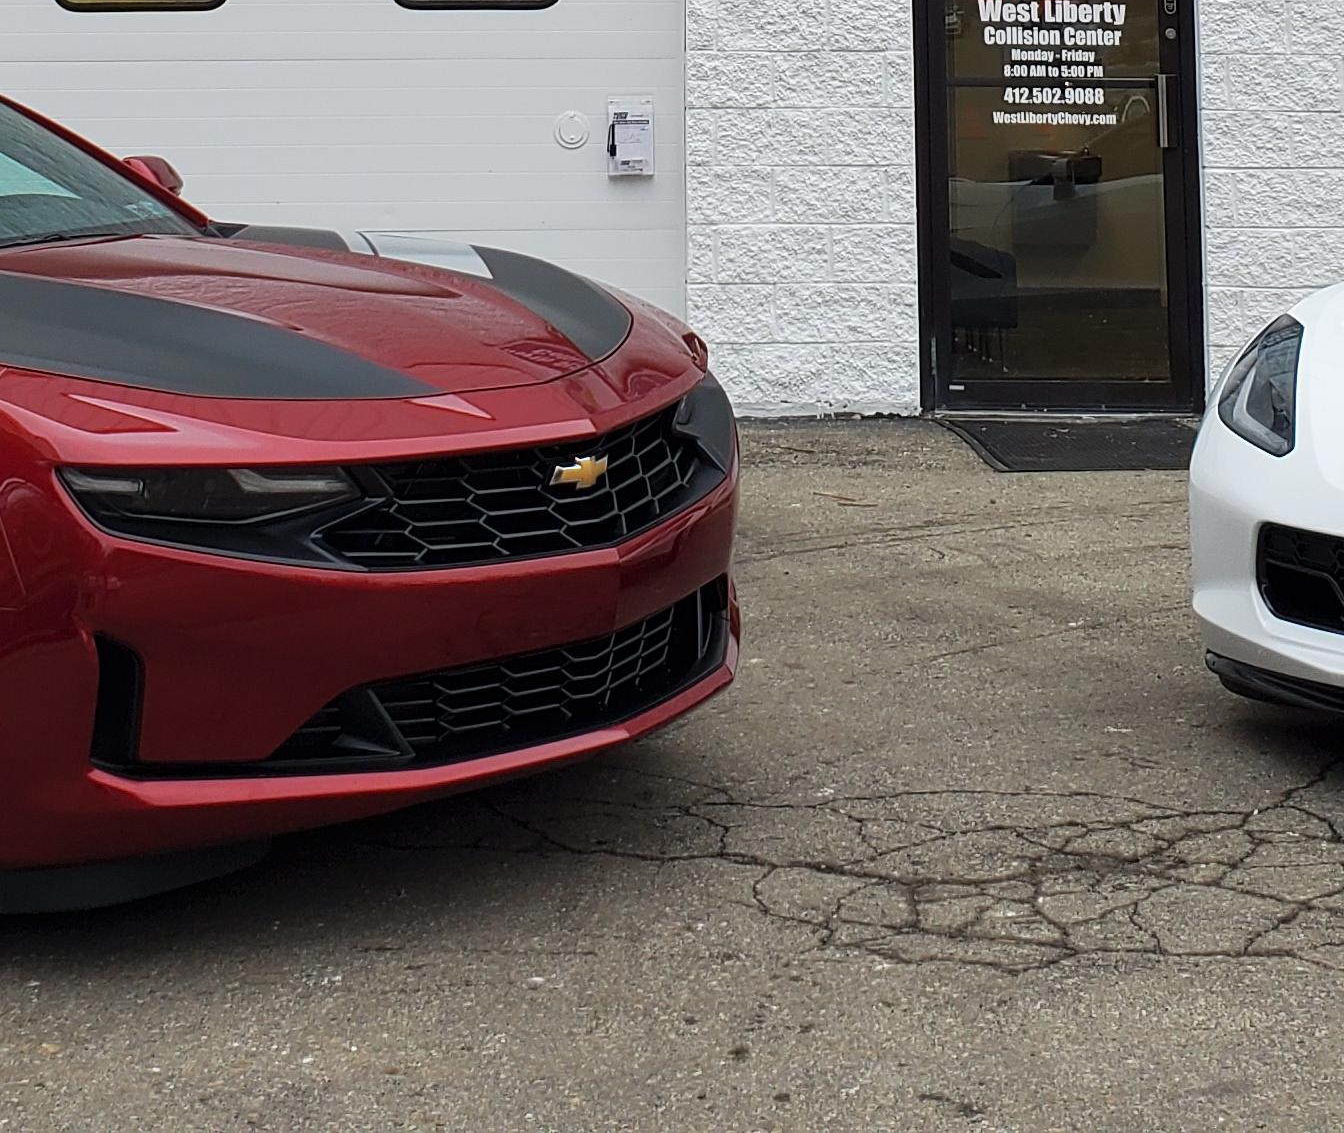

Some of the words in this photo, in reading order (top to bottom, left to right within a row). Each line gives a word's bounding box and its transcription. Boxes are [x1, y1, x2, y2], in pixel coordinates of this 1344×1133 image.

[978, 0, 1040, 22] West
[1044, 0, 1126, 25] Liberty
[984, 26, 1061, 45] Collision
[1064, 27, 1122, 45] Center
[1011, 49, 1054, 62] Monday
[1061, 49, 1095, 62] Friday
[1003, 65, 1029, 77] 8:00
[1029, 65, 1046, 77] AM
[1047, 65, 1059, 77] to
[1061, 65, 1085, 77] 5:00
[1087, 66, 1104, 77] PM
[1003, 87, 1104, 105] 412.502.9088
[993, 111, 1117, 125] WestLibertyChevy.com
